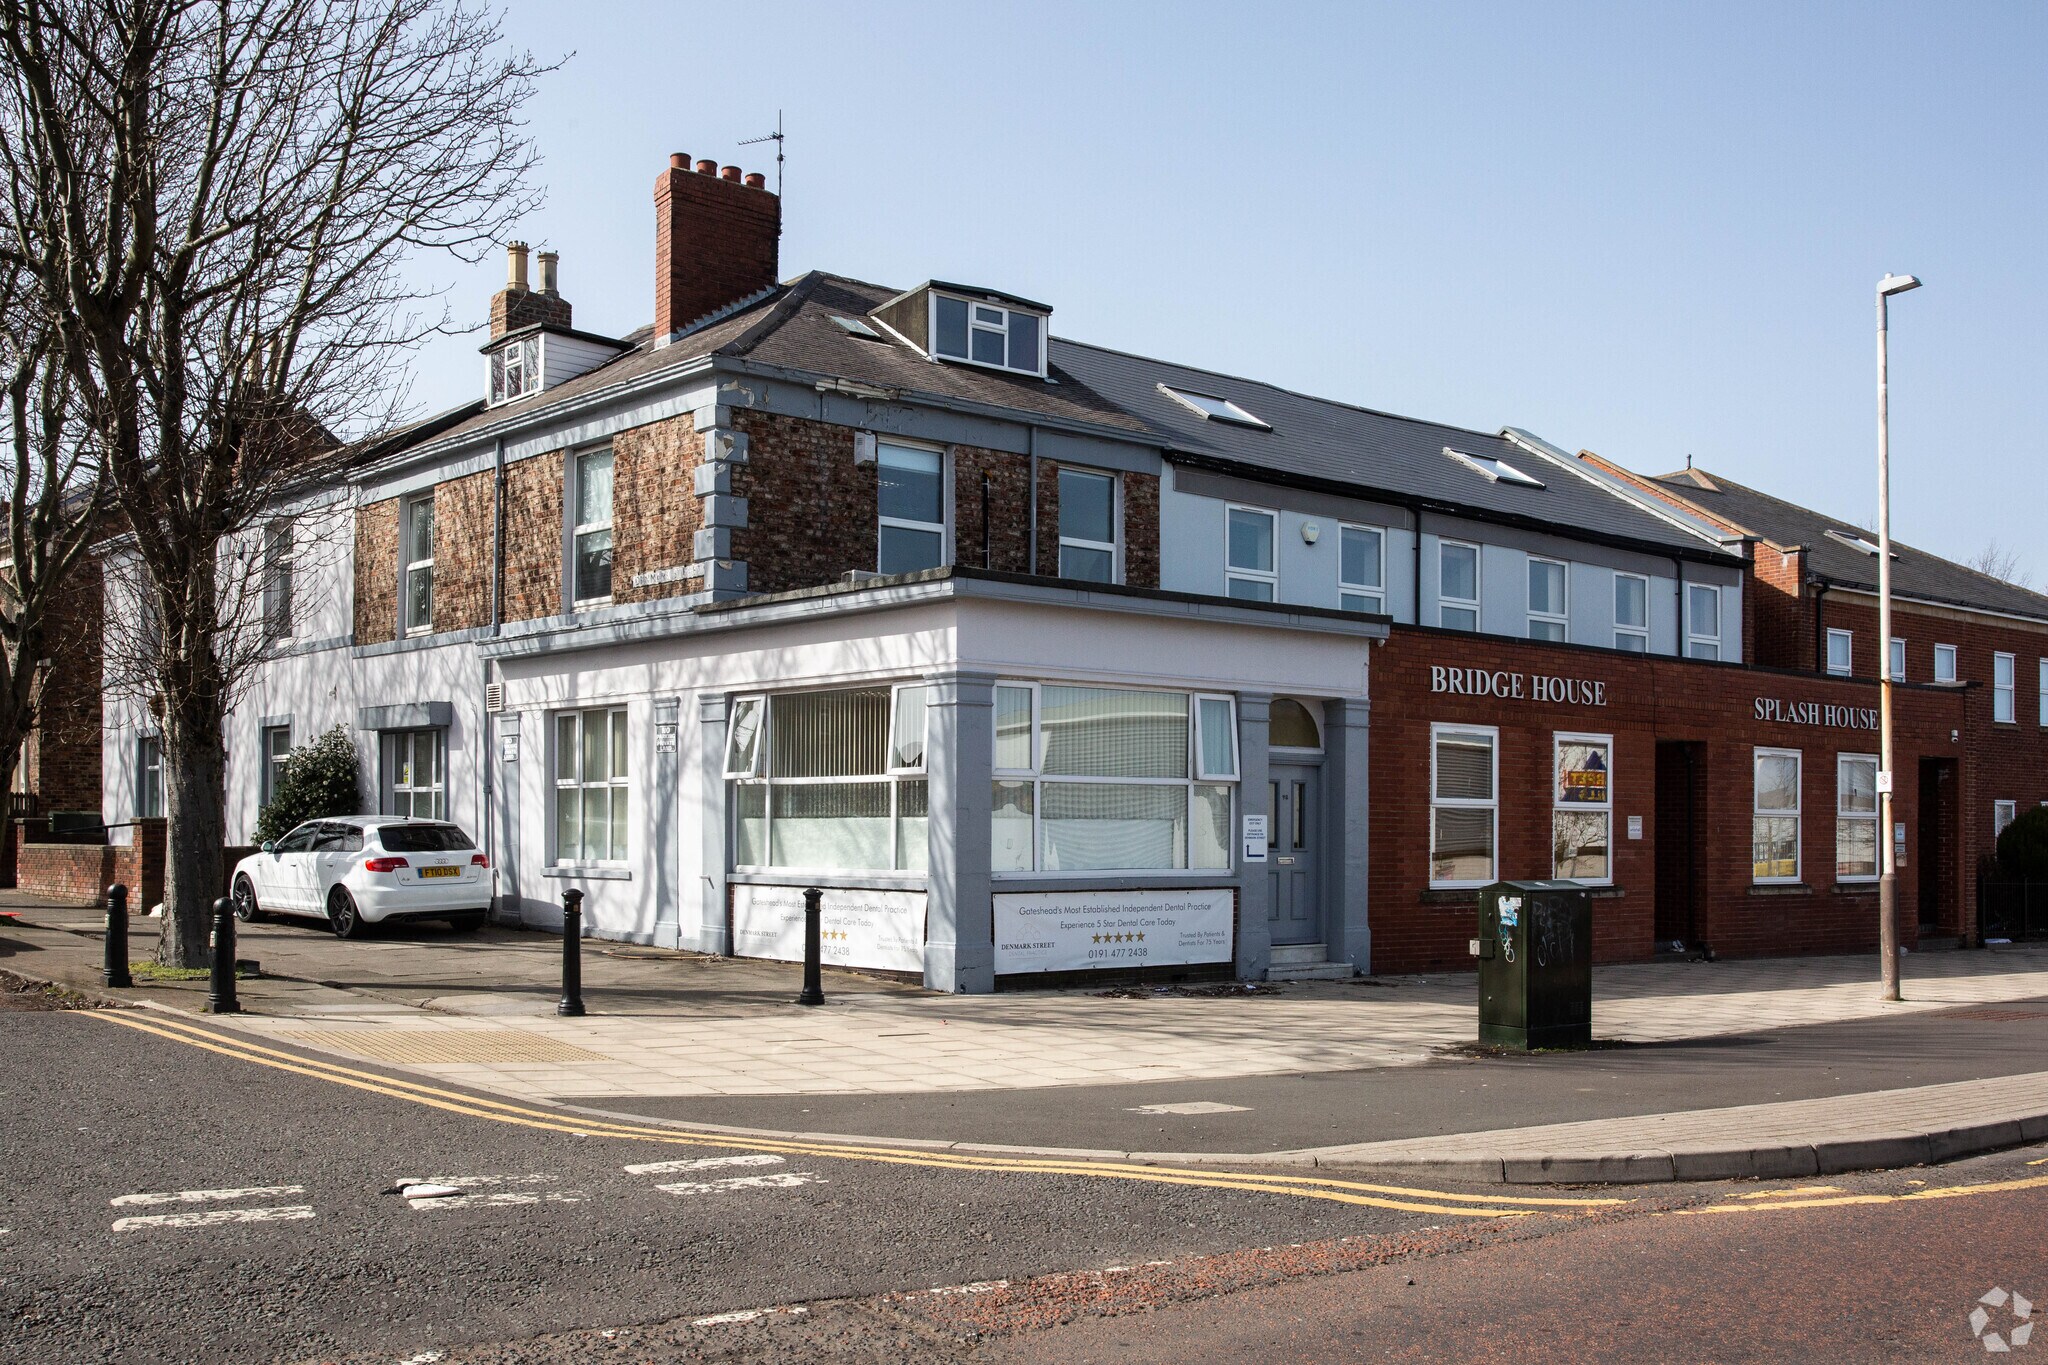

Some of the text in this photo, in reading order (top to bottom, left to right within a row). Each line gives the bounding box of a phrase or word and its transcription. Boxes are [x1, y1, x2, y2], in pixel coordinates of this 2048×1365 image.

[1430, 665, 1607, 706] BRIDGE HOUSE
[1754, 697, 1879, 730] SPLASH HOUSE
[425, 867, 458, 877] FT10 DSX
[751, 898, 782, 907] Gateshead's
[783, 900, 796, 908] Most
[827, 902, 863, 913] Independent
[864, 903, 883, 912] Dental
[885, 904, 908, 914] Practice
[1019, 902, 1211, 916] Gateshead's Most Established Independent Dental Practice
[780, 914, 806, 923] Experienc
[824, 916, 842, 925] Dental
[843, 917, 857, 926] Care
[858, 918, 874, 928] Today
[1060, 917, 1176, 930] Experience 5 Star Dental Care Today
[1179, 931, 1197, 939] Trusted
[1197, 931, 1204, 939] By
[1204, 930, 1221, 938] Patients
[833, 945, 850, 956] 2438
[1001, 941, 1056, 951] DENMARK STREET
[1088, 948, 1148, 959] 0191 477 2438
